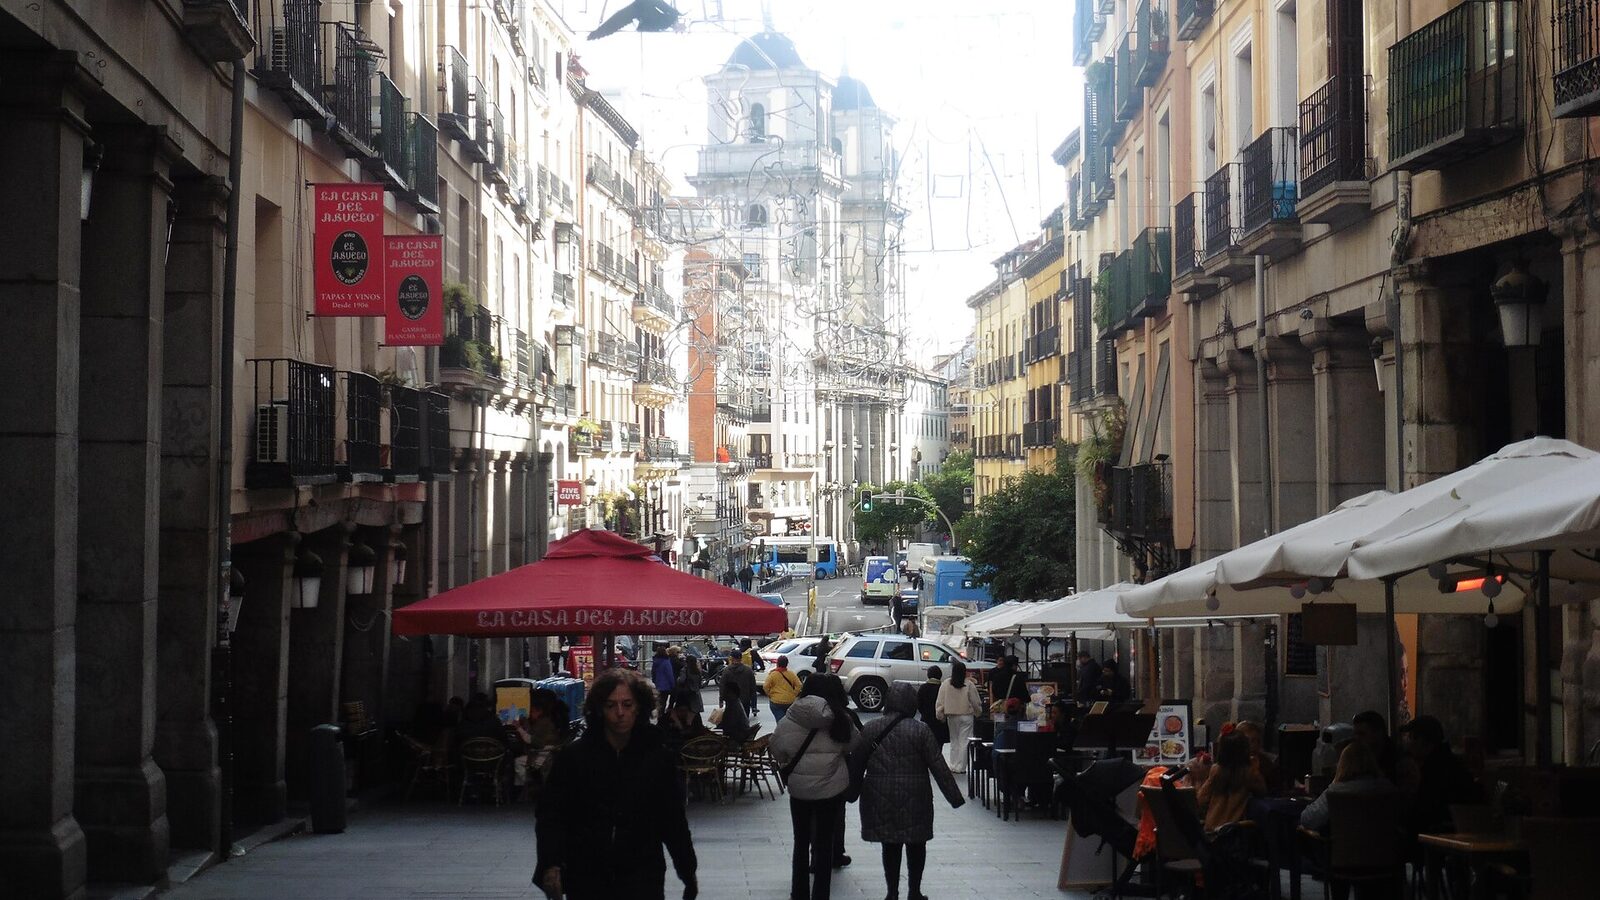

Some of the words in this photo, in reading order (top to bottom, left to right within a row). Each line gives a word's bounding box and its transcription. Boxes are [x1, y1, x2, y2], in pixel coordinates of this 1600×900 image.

[320, 191, 338, 201] LA
[341, 191, 378, 201] CASA
[336, 202, 363, 212] DEL
[321, 213, 375, 223] ABUELO
[389, 241, 404, 250] LA
[406, 241, 438, 250] CASA
[333, 251, 366, 260] ABUELO
[402, 250, 424, 259] DEL
[389, 260, 435, 268] ABUELO
[477, 611, 505, 627] LA
[510, 610, 568, 627] CASA
[574, 609, 615, 626] DEL
[618, 609, 703, 627] ABUELO
